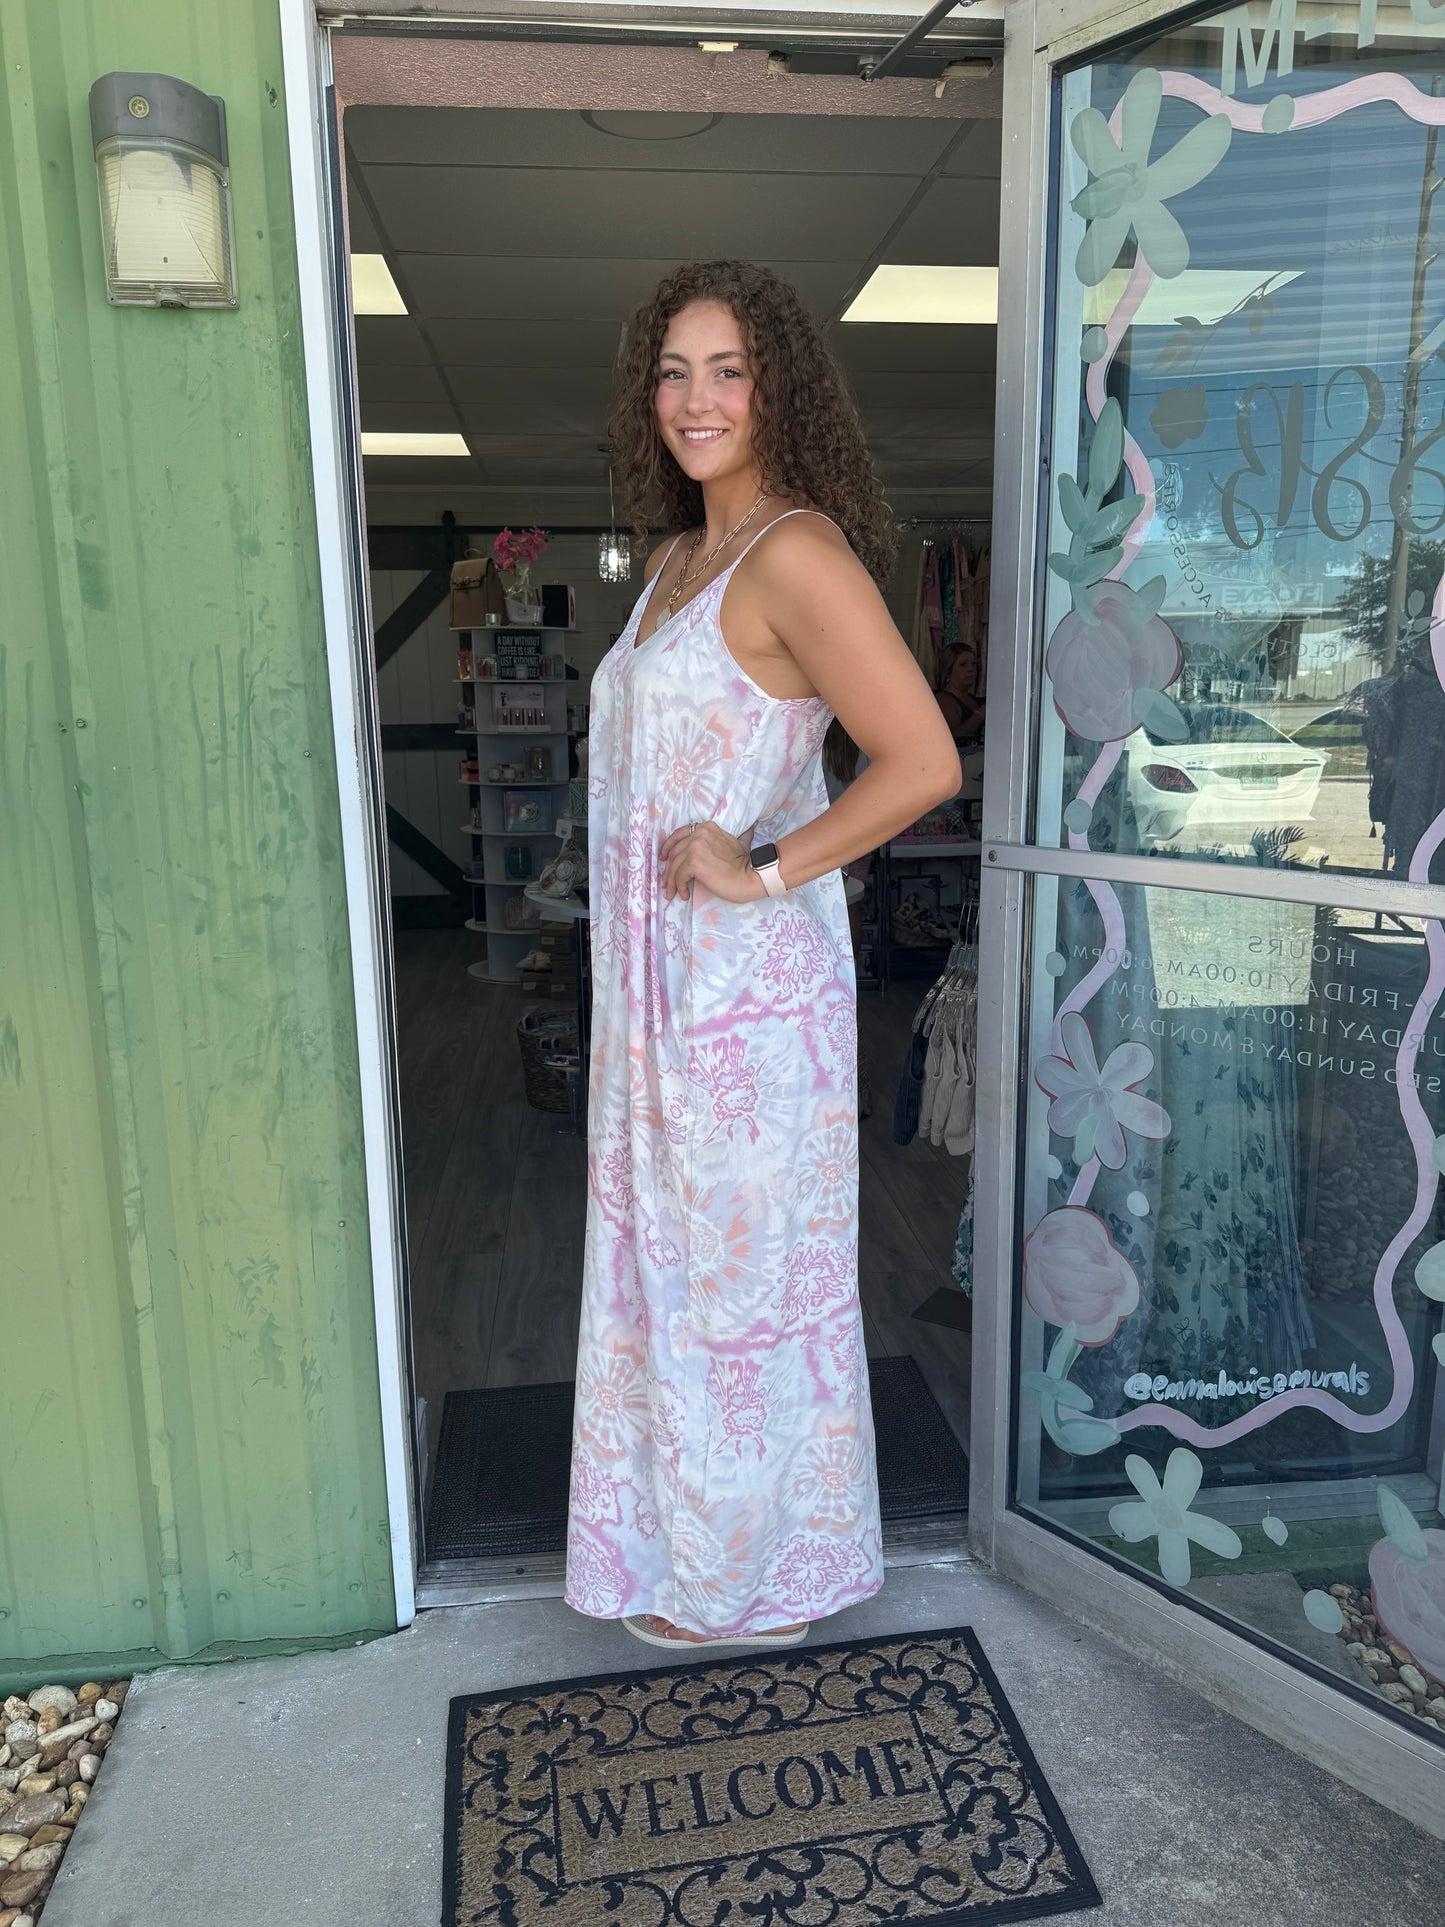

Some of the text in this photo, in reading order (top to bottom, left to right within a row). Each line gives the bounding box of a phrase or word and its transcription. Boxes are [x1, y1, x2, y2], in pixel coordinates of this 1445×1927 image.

[497, 646, 517, 656] COFFEE
[502, 635, 513, 646] DAY
[514, 636, 540, 646] WITHOUT
[1123, 1360, 1371, 1401] @emmalouisemurals
[568, 1738, 929, 1838] WELCOME
